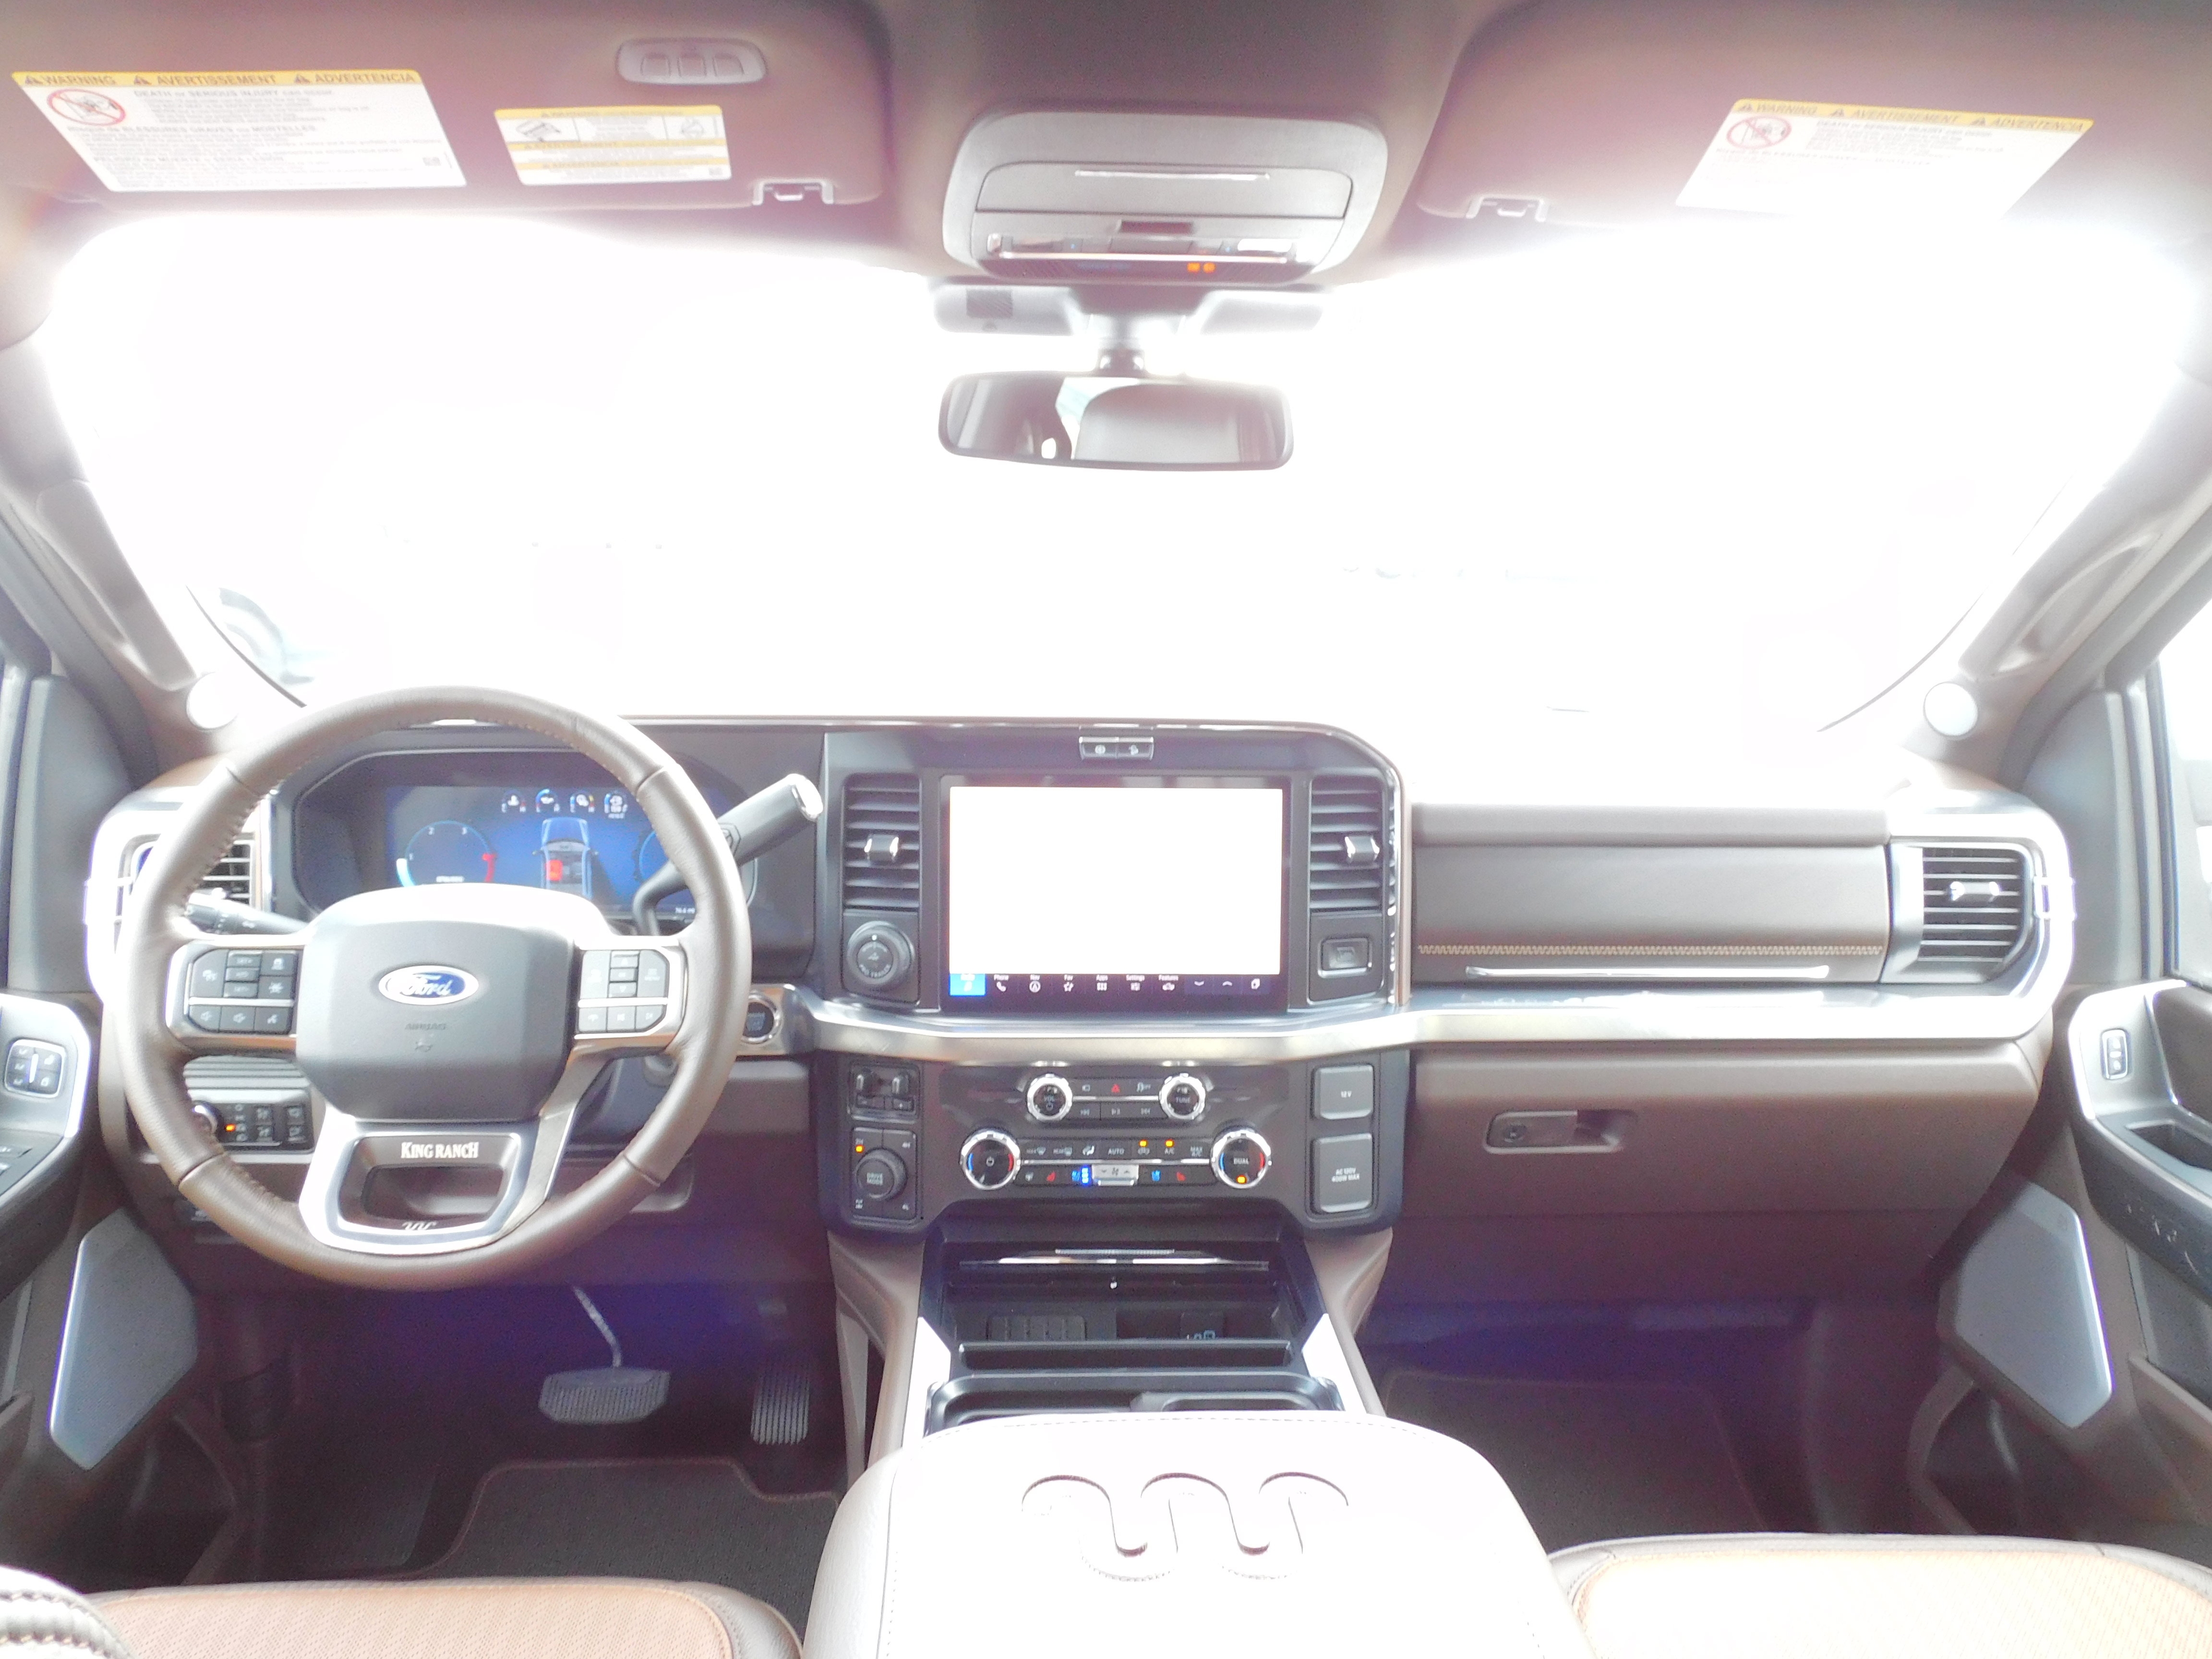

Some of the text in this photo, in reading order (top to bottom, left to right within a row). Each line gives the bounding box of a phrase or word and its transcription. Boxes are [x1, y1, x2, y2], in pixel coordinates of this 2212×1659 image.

[42, 72, 416, 85] WARNING AVERTISSEMENT ADVERTENCIA
[1756, 103, 2084, 131] WARNING AVERTISSEMENT ADVERTENCIA
[400, 1142, 479, 1158] KING RANCH
